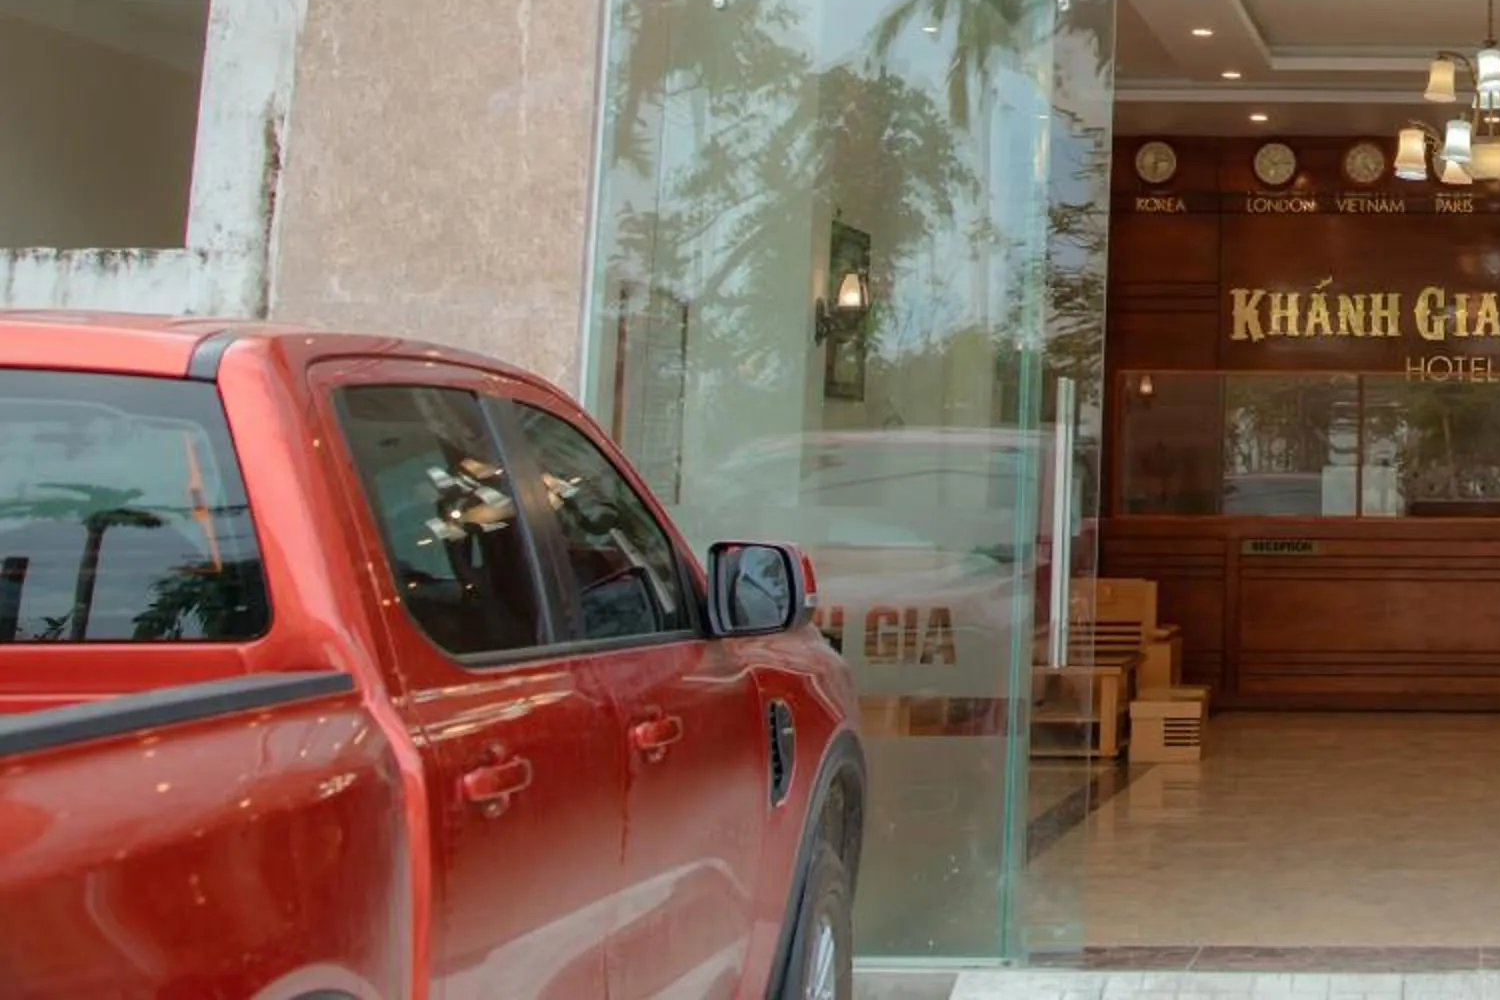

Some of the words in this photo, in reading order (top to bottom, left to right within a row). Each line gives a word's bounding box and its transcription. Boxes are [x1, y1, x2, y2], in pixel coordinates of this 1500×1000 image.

[1135, 197, 1187, 214] KOREA
[1246, 197, 1316, 214] LONDON
[1336, 197, 1406, 214] VIETNAM
[1435, 197, 1473, 214] PARIS
[1229, 275, 1402, 342] KHÁNH
[1405, 355, 1499, 383] HOTEL
[863, 605, 957, 665] GIA
